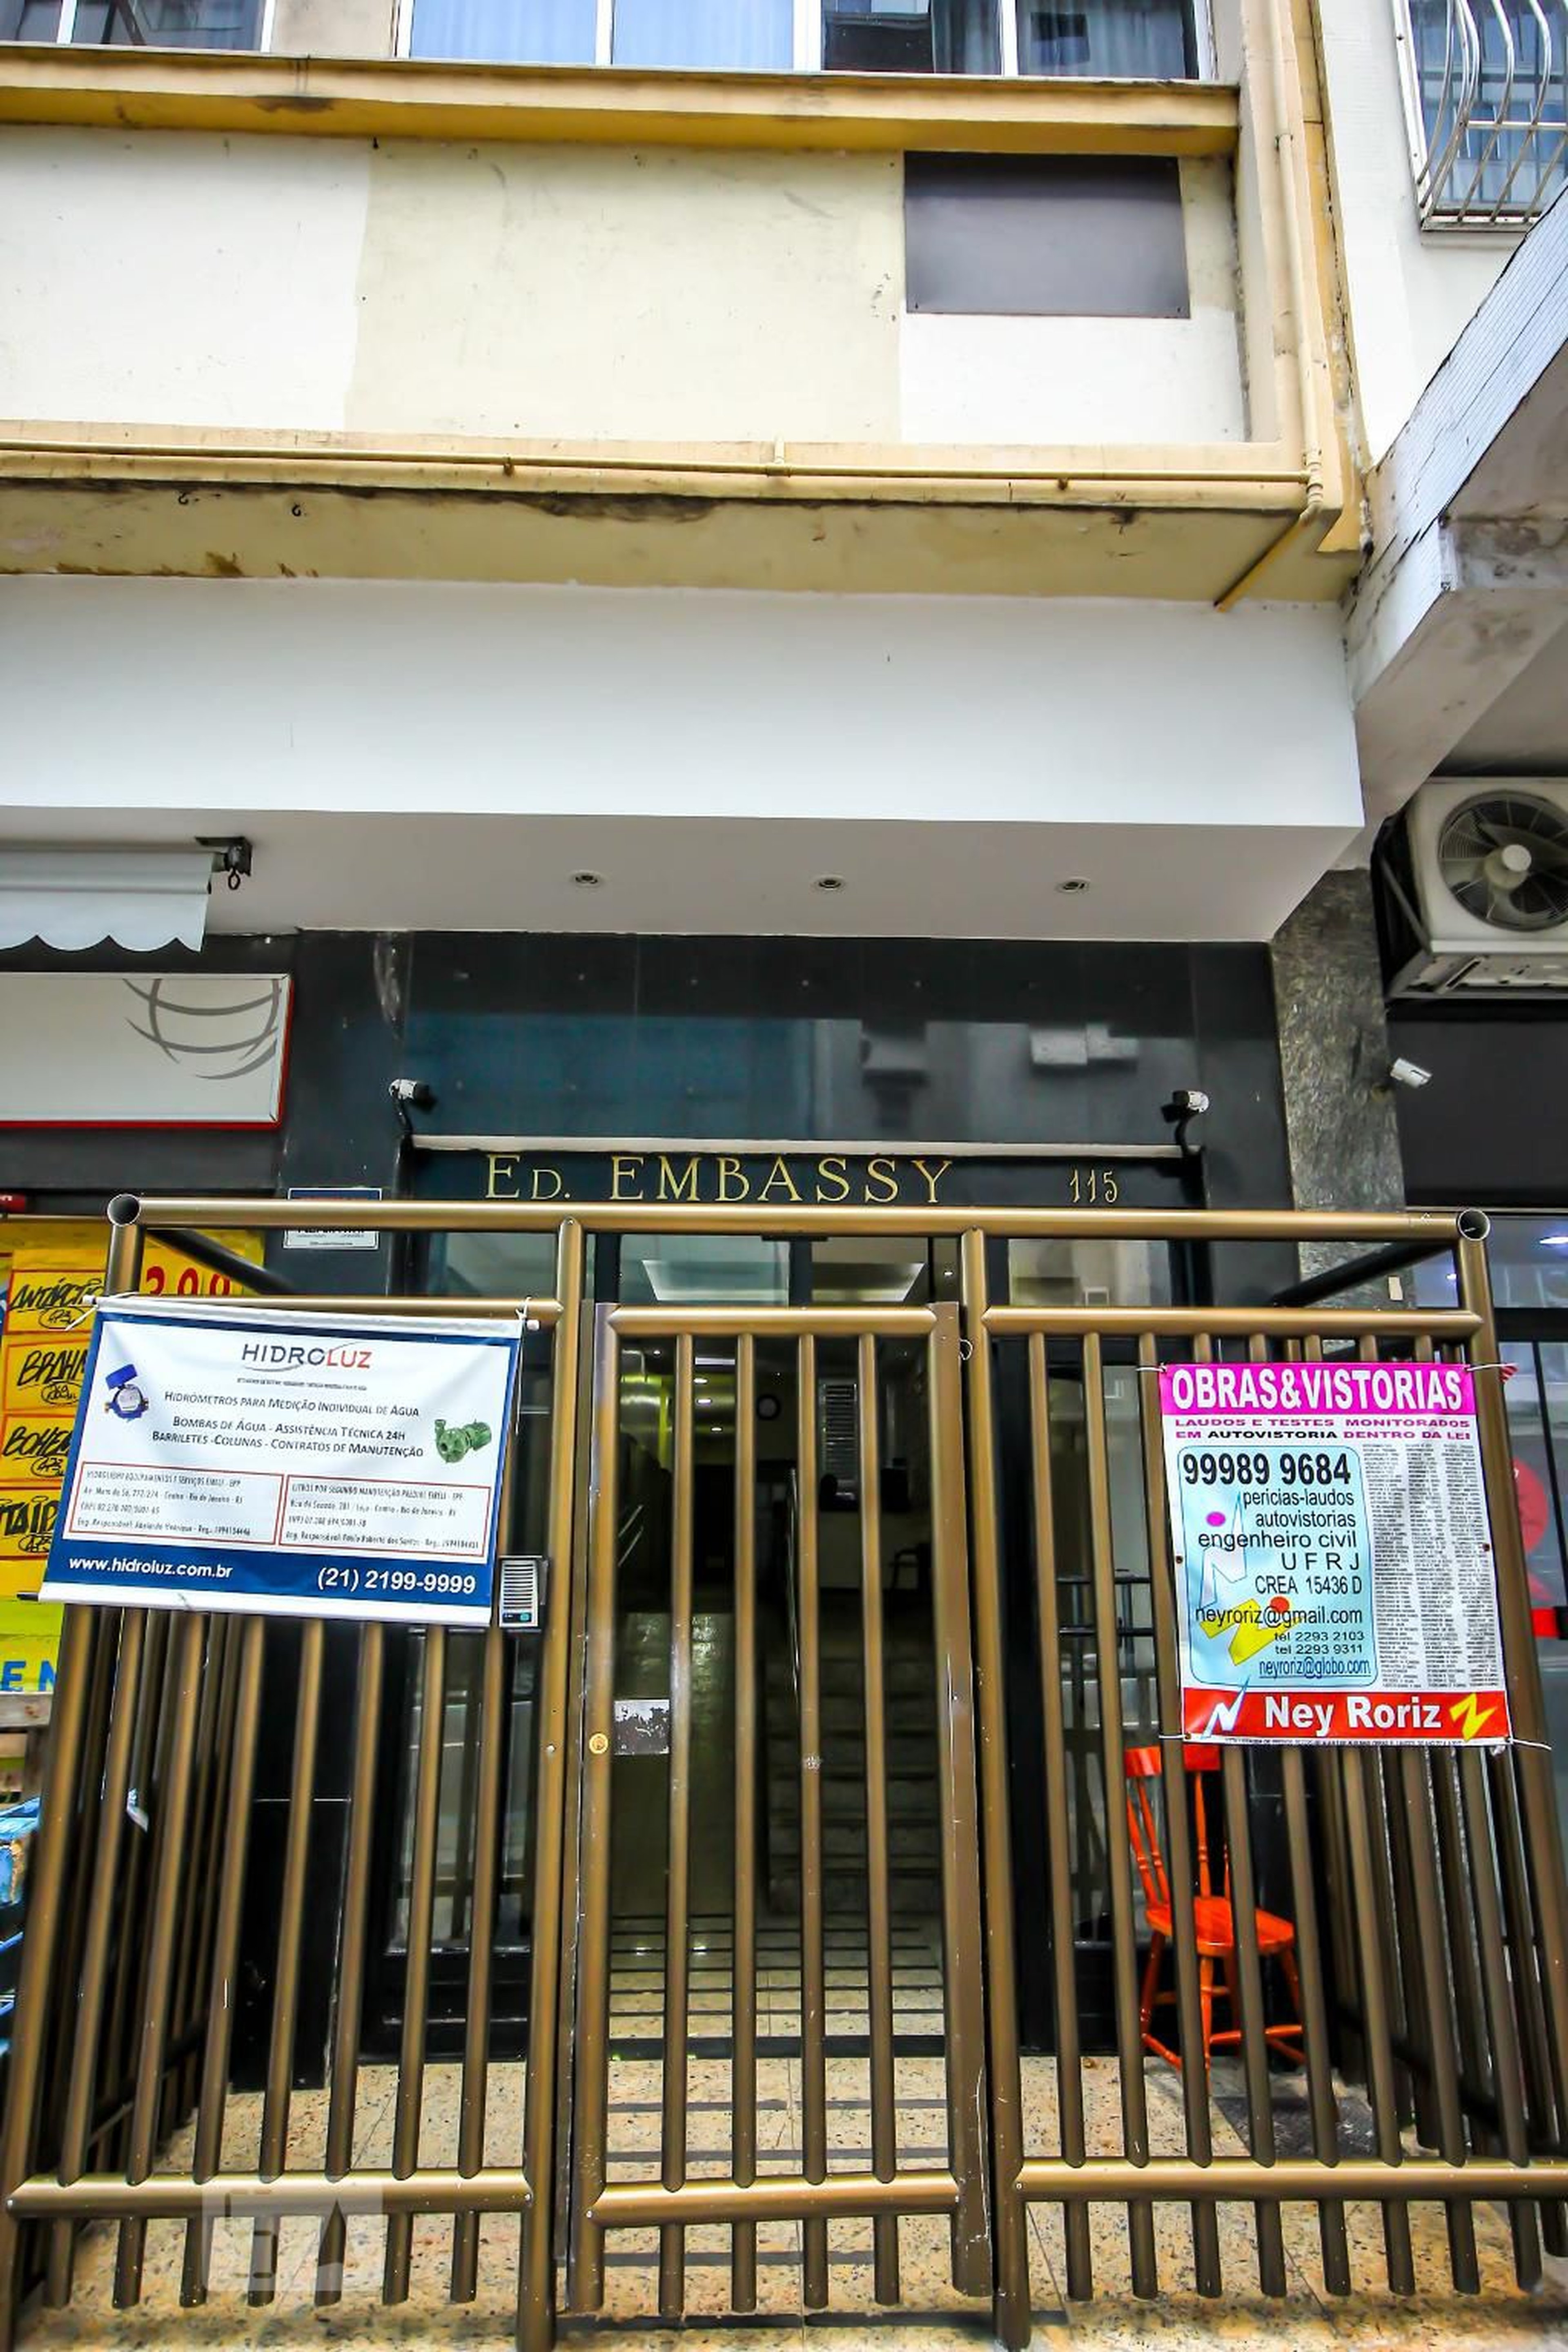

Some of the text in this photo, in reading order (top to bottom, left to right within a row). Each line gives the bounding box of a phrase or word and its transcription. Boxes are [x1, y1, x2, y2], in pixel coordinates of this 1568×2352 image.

[610, 1156, 952, 1203] EMBASSY
[1070, 1169, 1117, 1202] 115
[242, 1344, 372, 1368] HIDROLUZ
[1173, 1369, 1462, 1410] OBRAS&VISTORIAS
[241, 1398, 265, 1408] PARA
[268, 1399, 316, 1412] MEDIÇÃO
[318, 1402, 372, 1414] INDIVIDUAL
[376, 1406, 387, 1415] DE
[390, 1405, 419, 1416] ÁGUA
[173, 1416, 218, 1429] BOMBAS
[220, 1421, 232, 1429] DE
[236, 1418, 265, 1431] ÁGUA
[275, 1424, 337, 1437] ASSISTÊNCIA
[341, 1427, 383, 1438] TÉCNICA
[386, 1431, 405, 1440] 24H
[1345, 1419, 1470, 1428] MONITORADOS
[153, 1431, 207, 1444] BARRILETES
[271, 1439, 330, 1451] CONTRATOS
[349, 1444, 423, 1457] MANUTENÇÃO
[1183, 1453, 1351, 1484] 99989 9684
[1244, 1489, 1354, 1510] pericias-laudos
[1256, 1510, 1356, 1527] autovistorias
[1198, 1530, 1356, 1552] engenheiro civil
[69, 1557, 233, 1578] www.hidroluz.com.br
[318, 1568, 476, 1593] (21) 2199-9999
[1255, 1575, 1362, 1594] CREA 15436 D
[1196, 1605, 1363, 1628] neyroriz@gmail.com
[1274, 1632, 1365, 1641] tel 2293 2103
[1275, 1645, 1363, 1654] tel 2293 9311
[1260, 1656, 1370, 1679] neyroriz@globo.com
[1265, 1696, 1442, 1737] Ney Roriz
